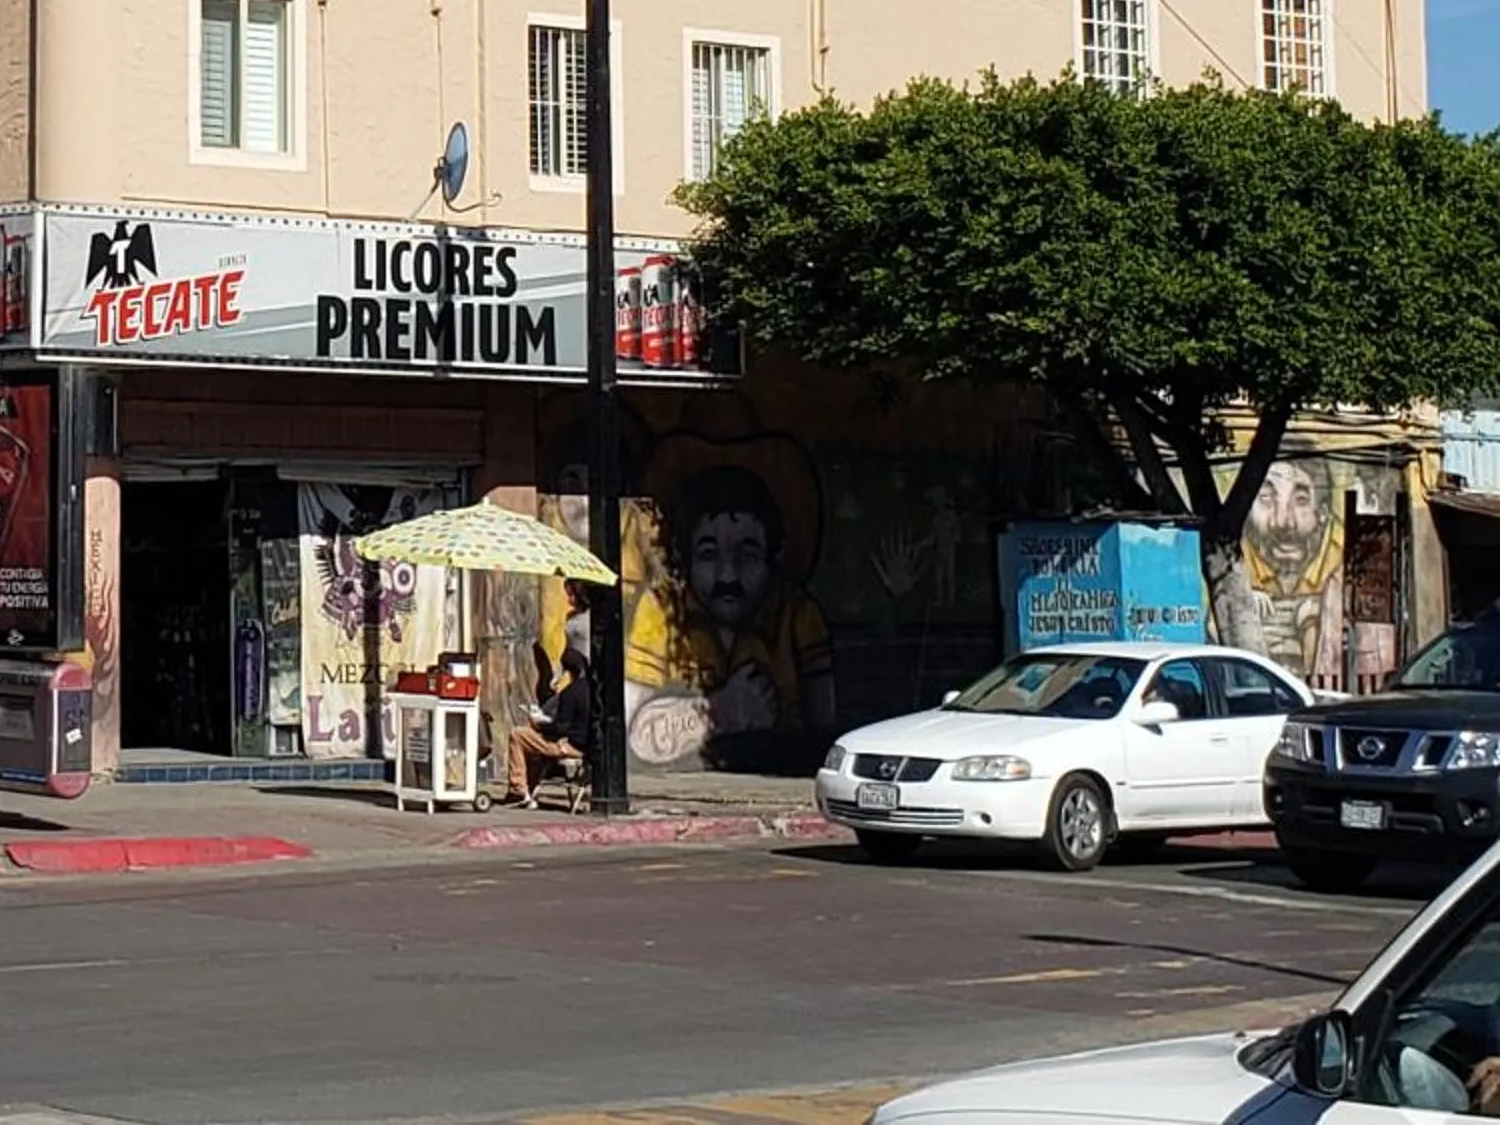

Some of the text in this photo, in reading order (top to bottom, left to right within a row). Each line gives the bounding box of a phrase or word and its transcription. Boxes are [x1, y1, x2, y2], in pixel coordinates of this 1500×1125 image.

[354, 238, 518, 297] LICORES
[83, 269, 246, 347] TECATE
[316, 295, 557, 366] PREMIUM
[0, 595, 49, 609] POSITIVA
